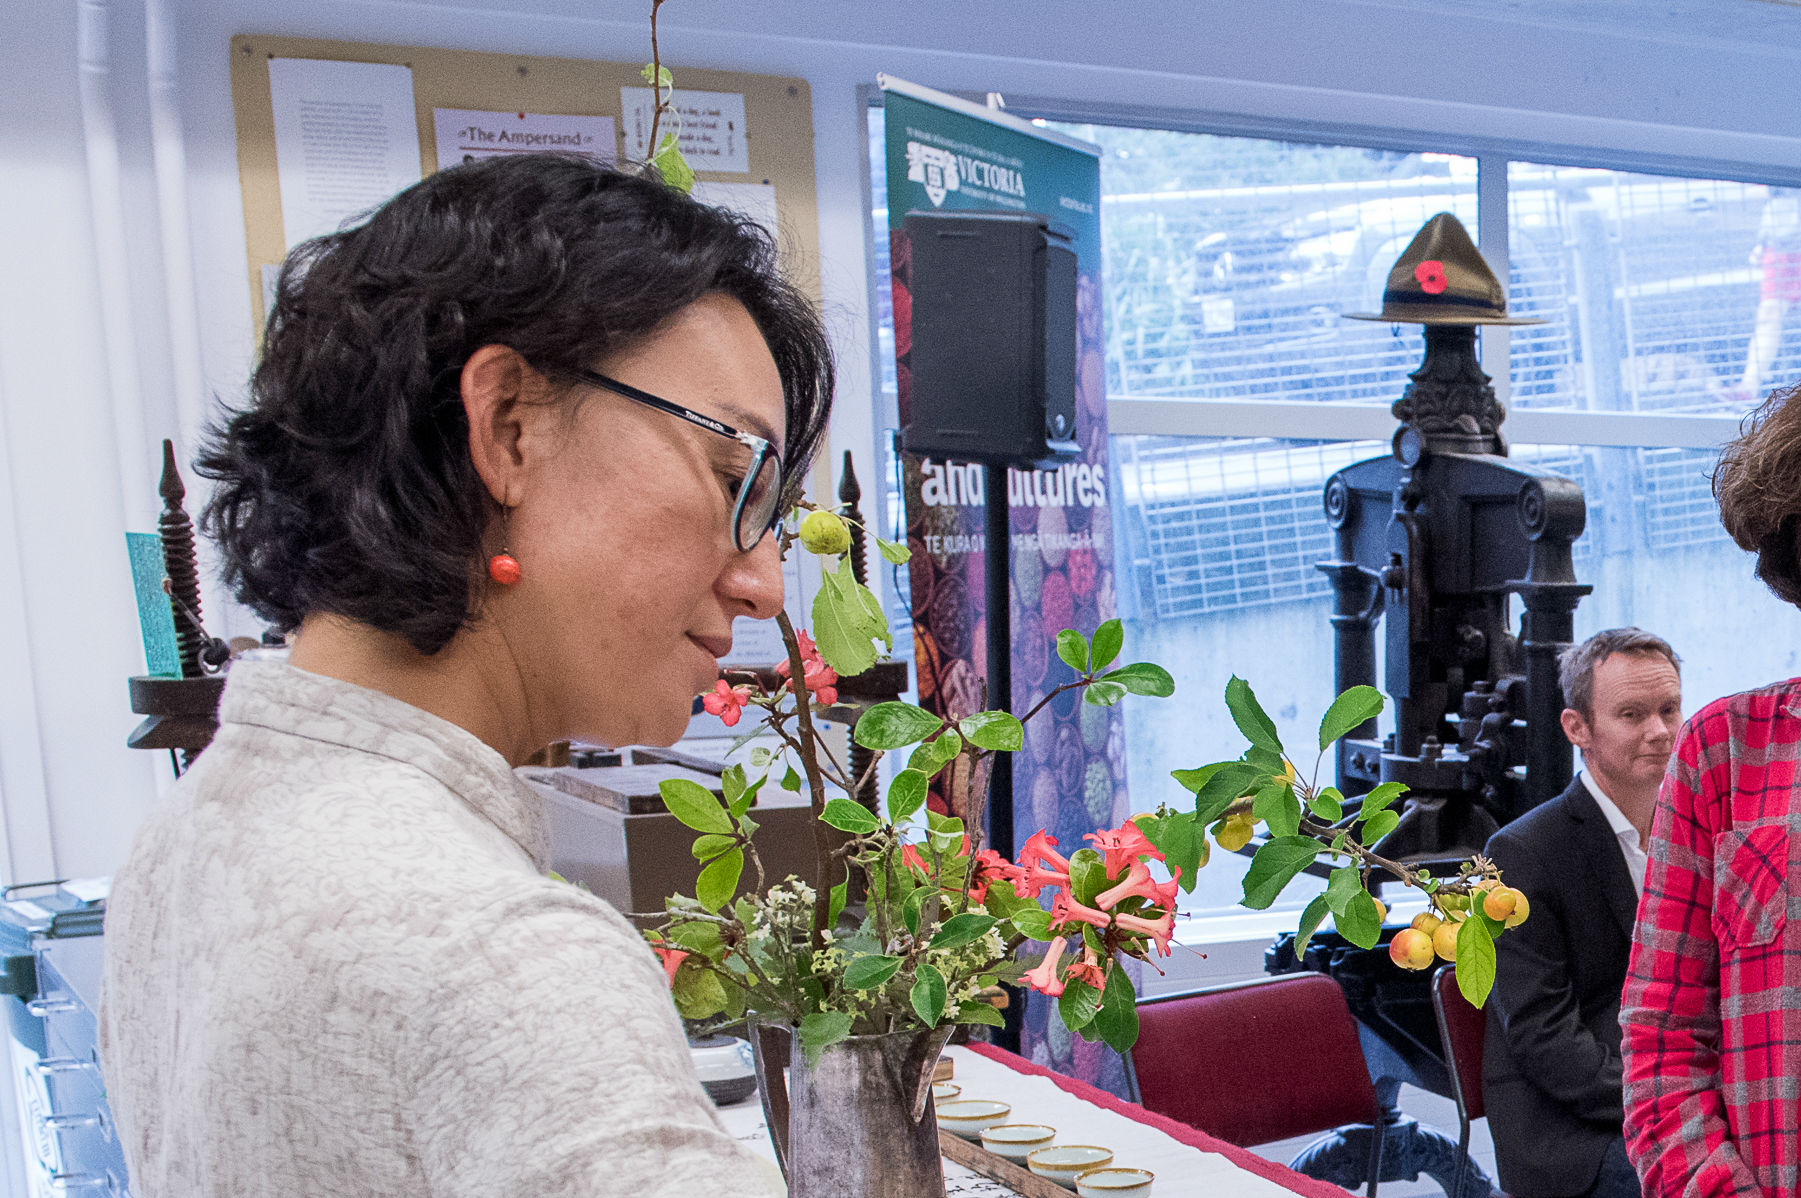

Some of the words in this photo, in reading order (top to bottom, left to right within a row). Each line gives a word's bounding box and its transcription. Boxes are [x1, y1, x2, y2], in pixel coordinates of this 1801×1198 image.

[467, 126, 495, 143] The
[498, 130, 581, 146] Ampersand
[957, 154, 1027, 197] VICTORIA
